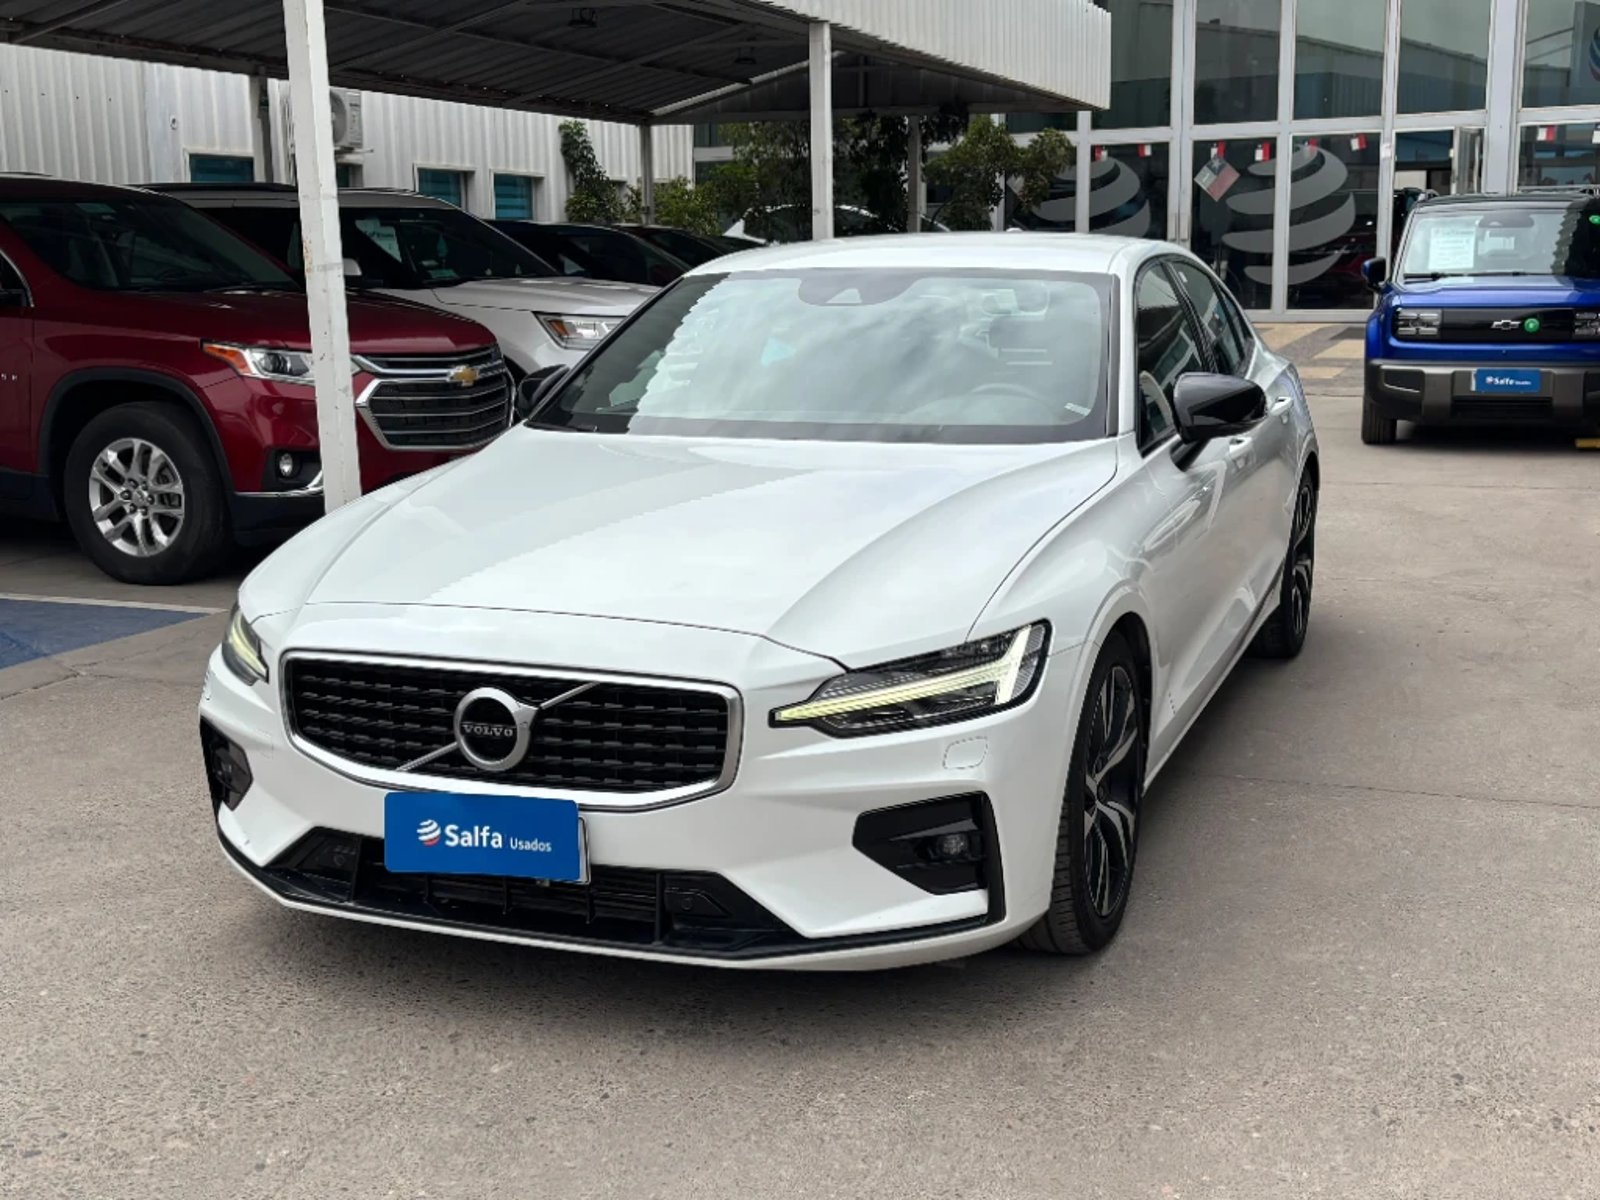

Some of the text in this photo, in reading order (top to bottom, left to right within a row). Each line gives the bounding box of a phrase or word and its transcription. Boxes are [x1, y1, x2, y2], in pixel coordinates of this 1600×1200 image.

[462, 724, 514, 737] VOLVO
[444, 824, 552, 852] Salfa Usados
